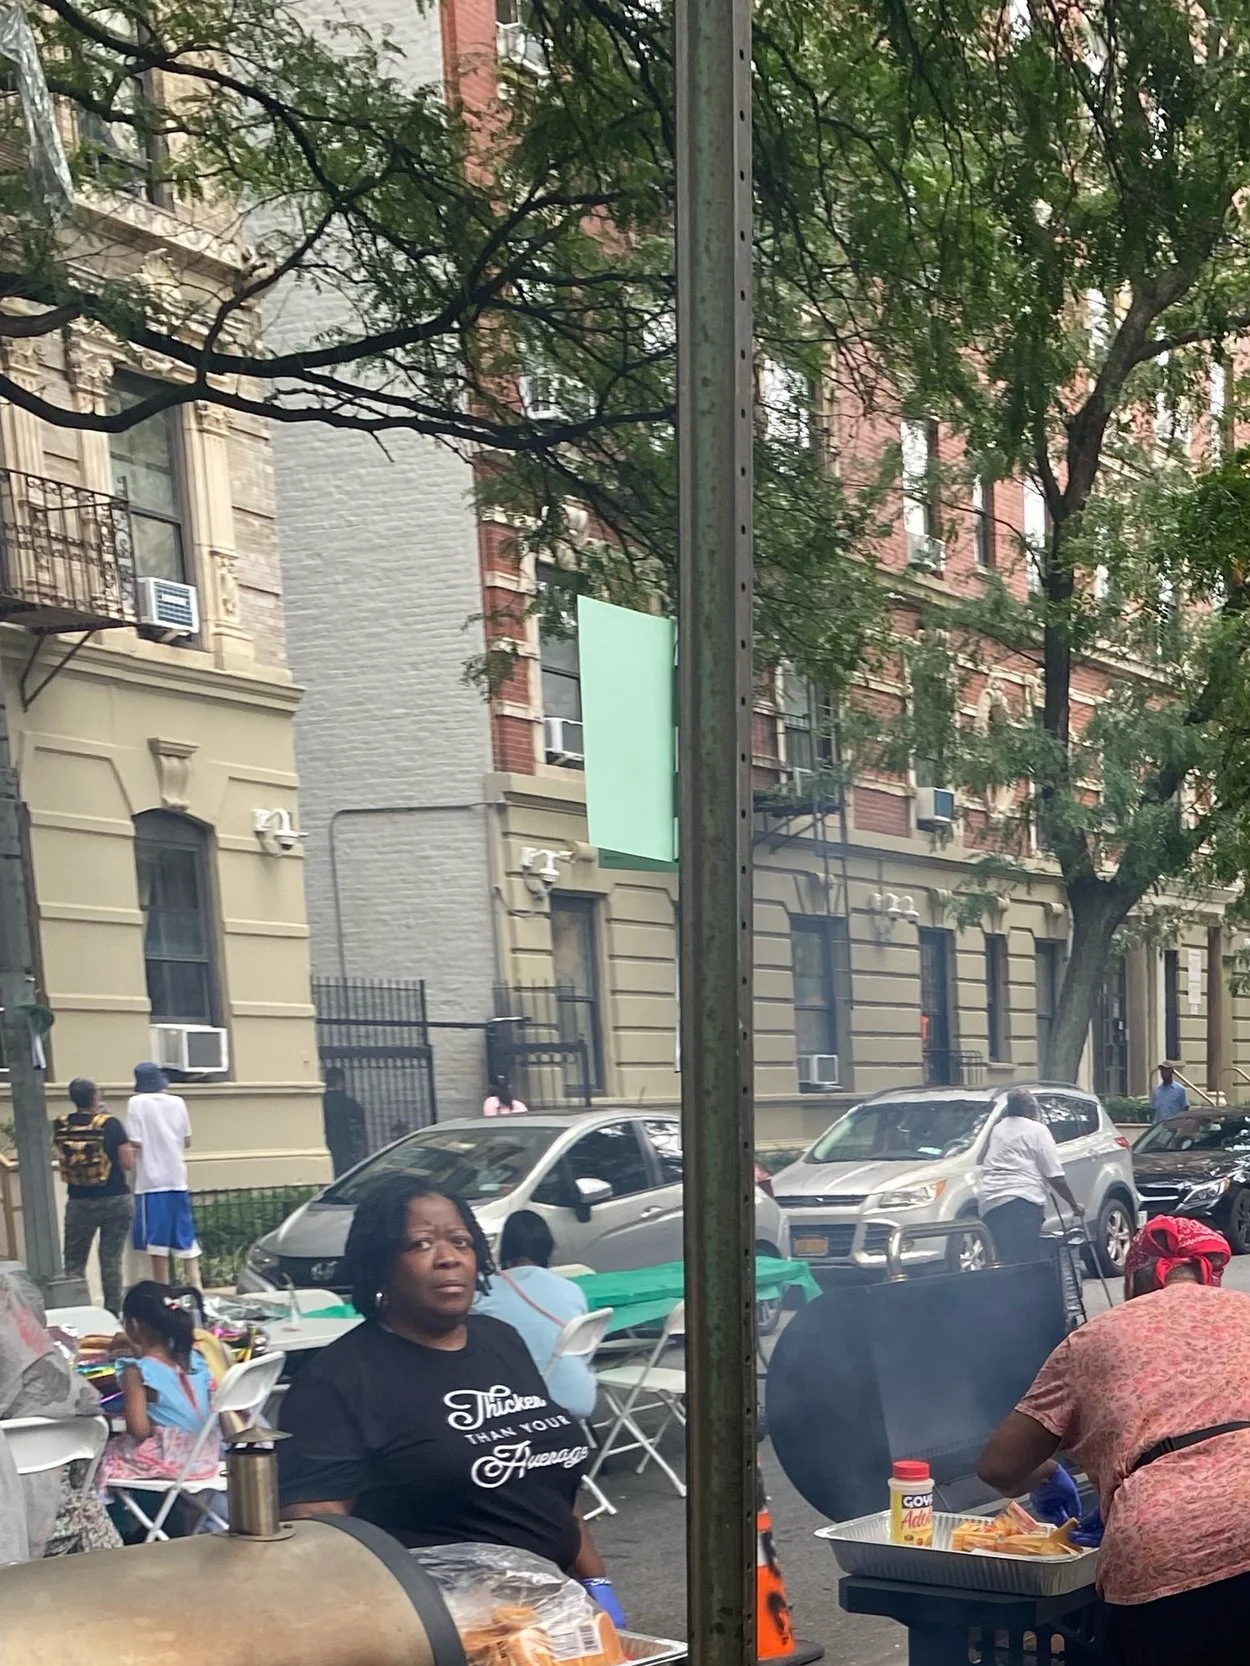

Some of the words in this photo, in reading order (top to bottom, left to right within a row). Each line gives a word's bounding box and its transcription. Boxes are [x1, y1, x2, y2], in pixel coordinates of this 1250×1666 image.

[444, 1385, 547, 1431] Thicker
[464, 1426, 518, 1445] THAN
[519, 1414, 572, 1434] YOUR
